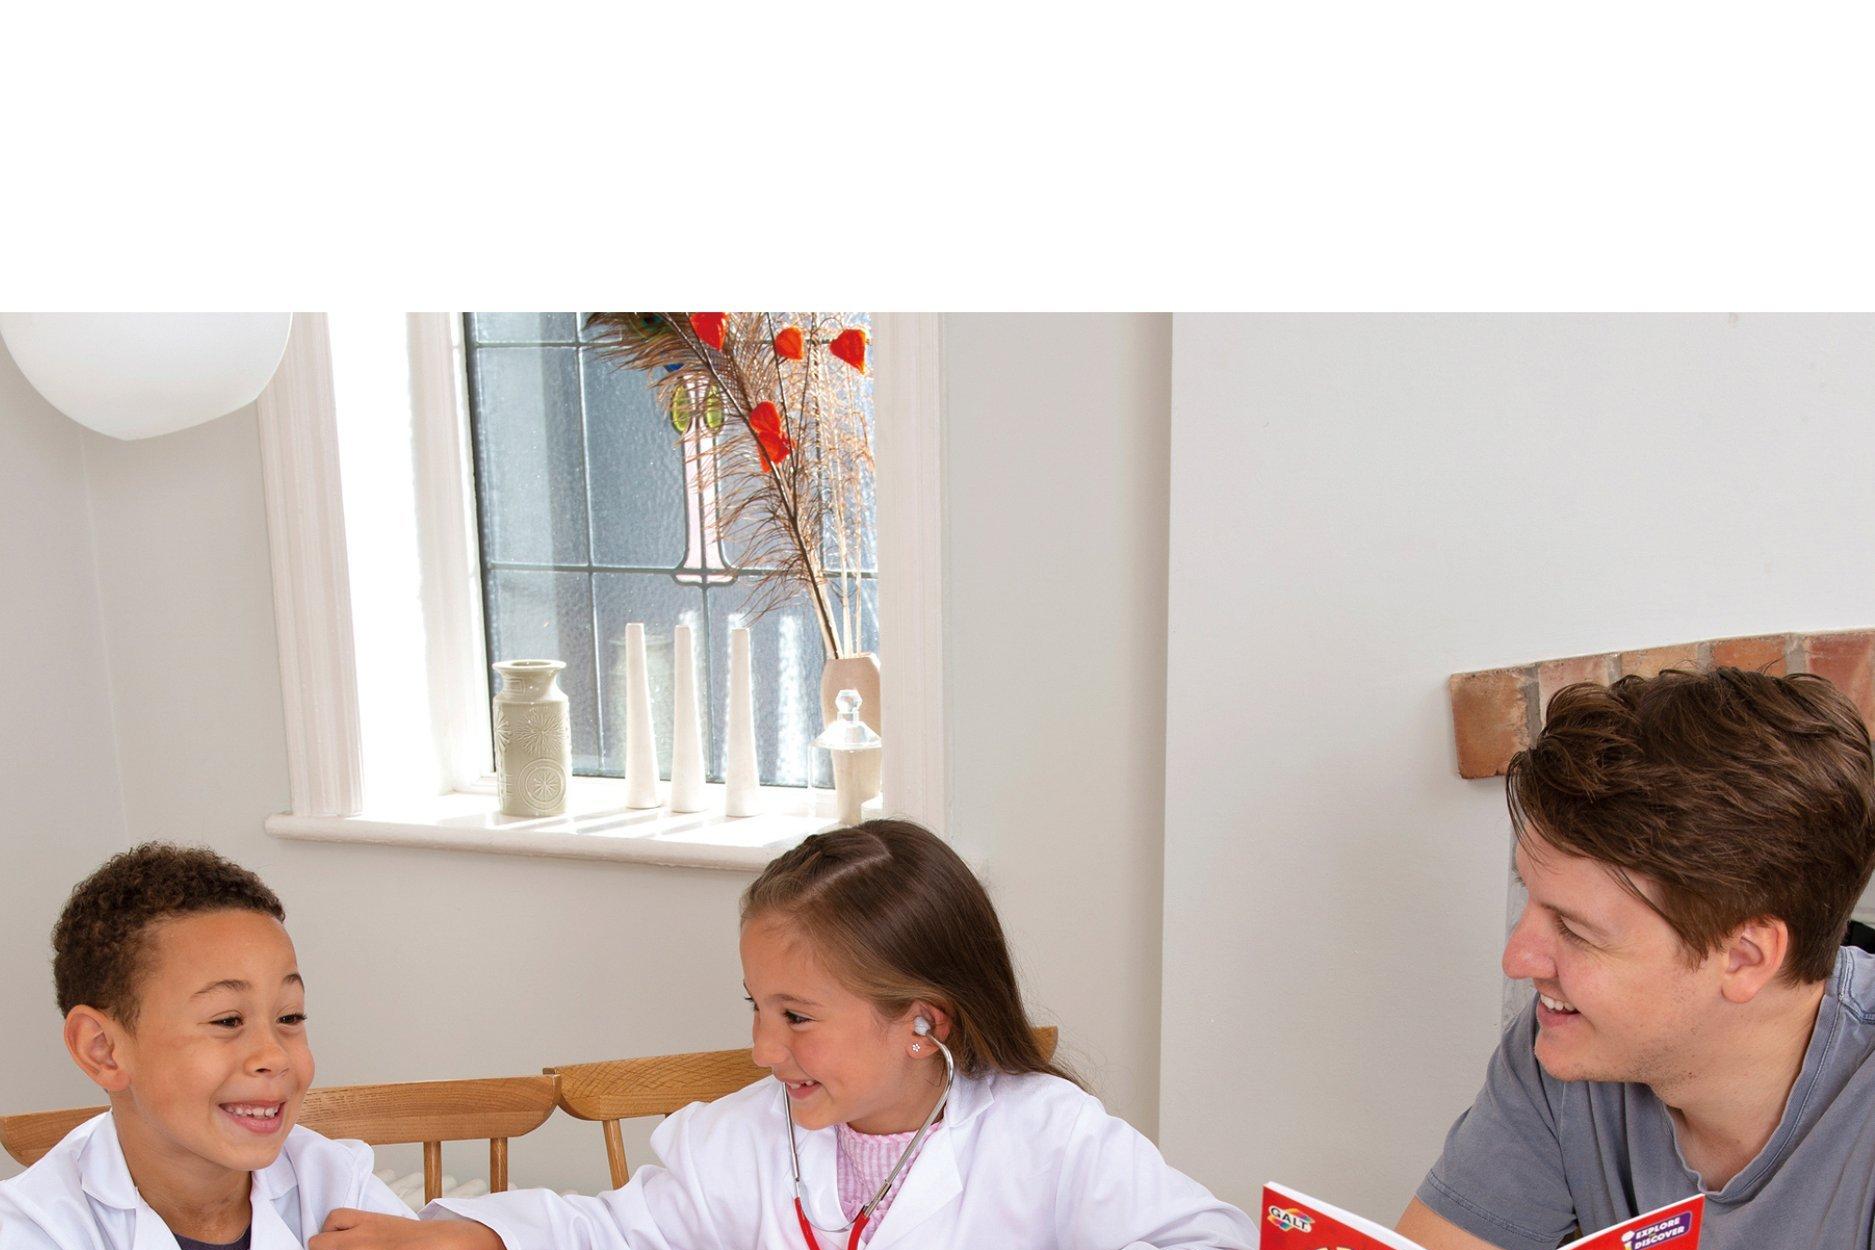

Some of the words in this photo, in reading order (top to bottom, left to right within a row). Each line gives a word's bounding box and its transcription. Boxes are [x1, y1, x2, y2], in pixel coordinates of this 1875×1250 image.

[1270, 1207, 1308, 1230] GALT
[1635, 1217, 1681, 1240] EXPLORE
[1635, 1226, 1685, 1250] DISCOVER
